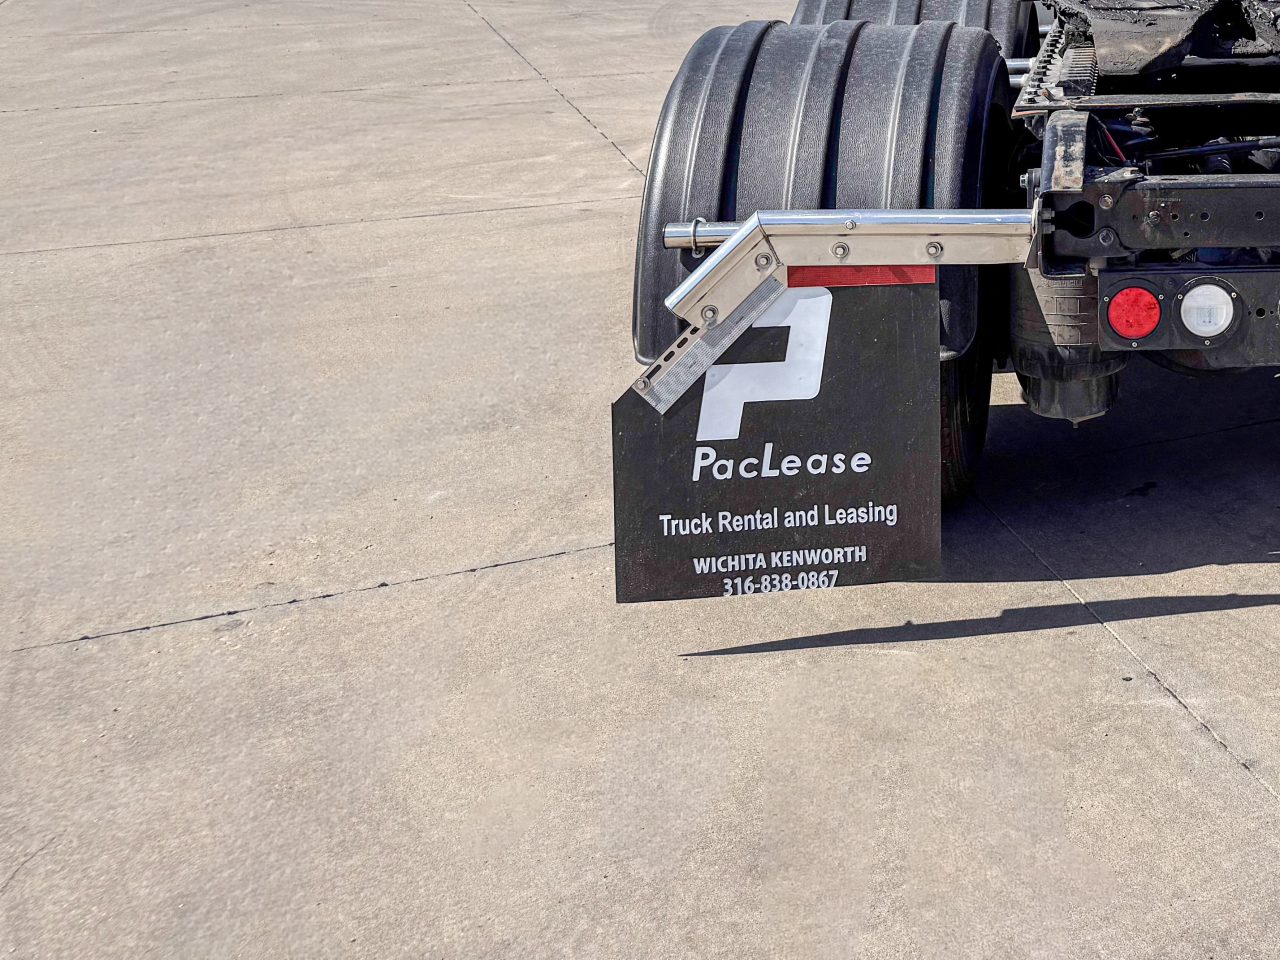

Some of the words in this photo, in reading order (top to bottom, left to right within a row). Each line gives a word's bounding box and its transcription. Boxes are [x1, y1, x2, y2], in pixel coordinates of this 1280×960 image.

[691, 442, 873, 482] PacLease
[659, 512, 713, 537] Truck
[718, 507, 779, 534] Rental
[783, 504, 819, 529] and
[824, 503, 898, 527] Leasing
[693, 552, 767, 574] WICHITA
[770, 545, 867, 568] KENWORTH
[723, 569, 839, 597] 316-838-0867
